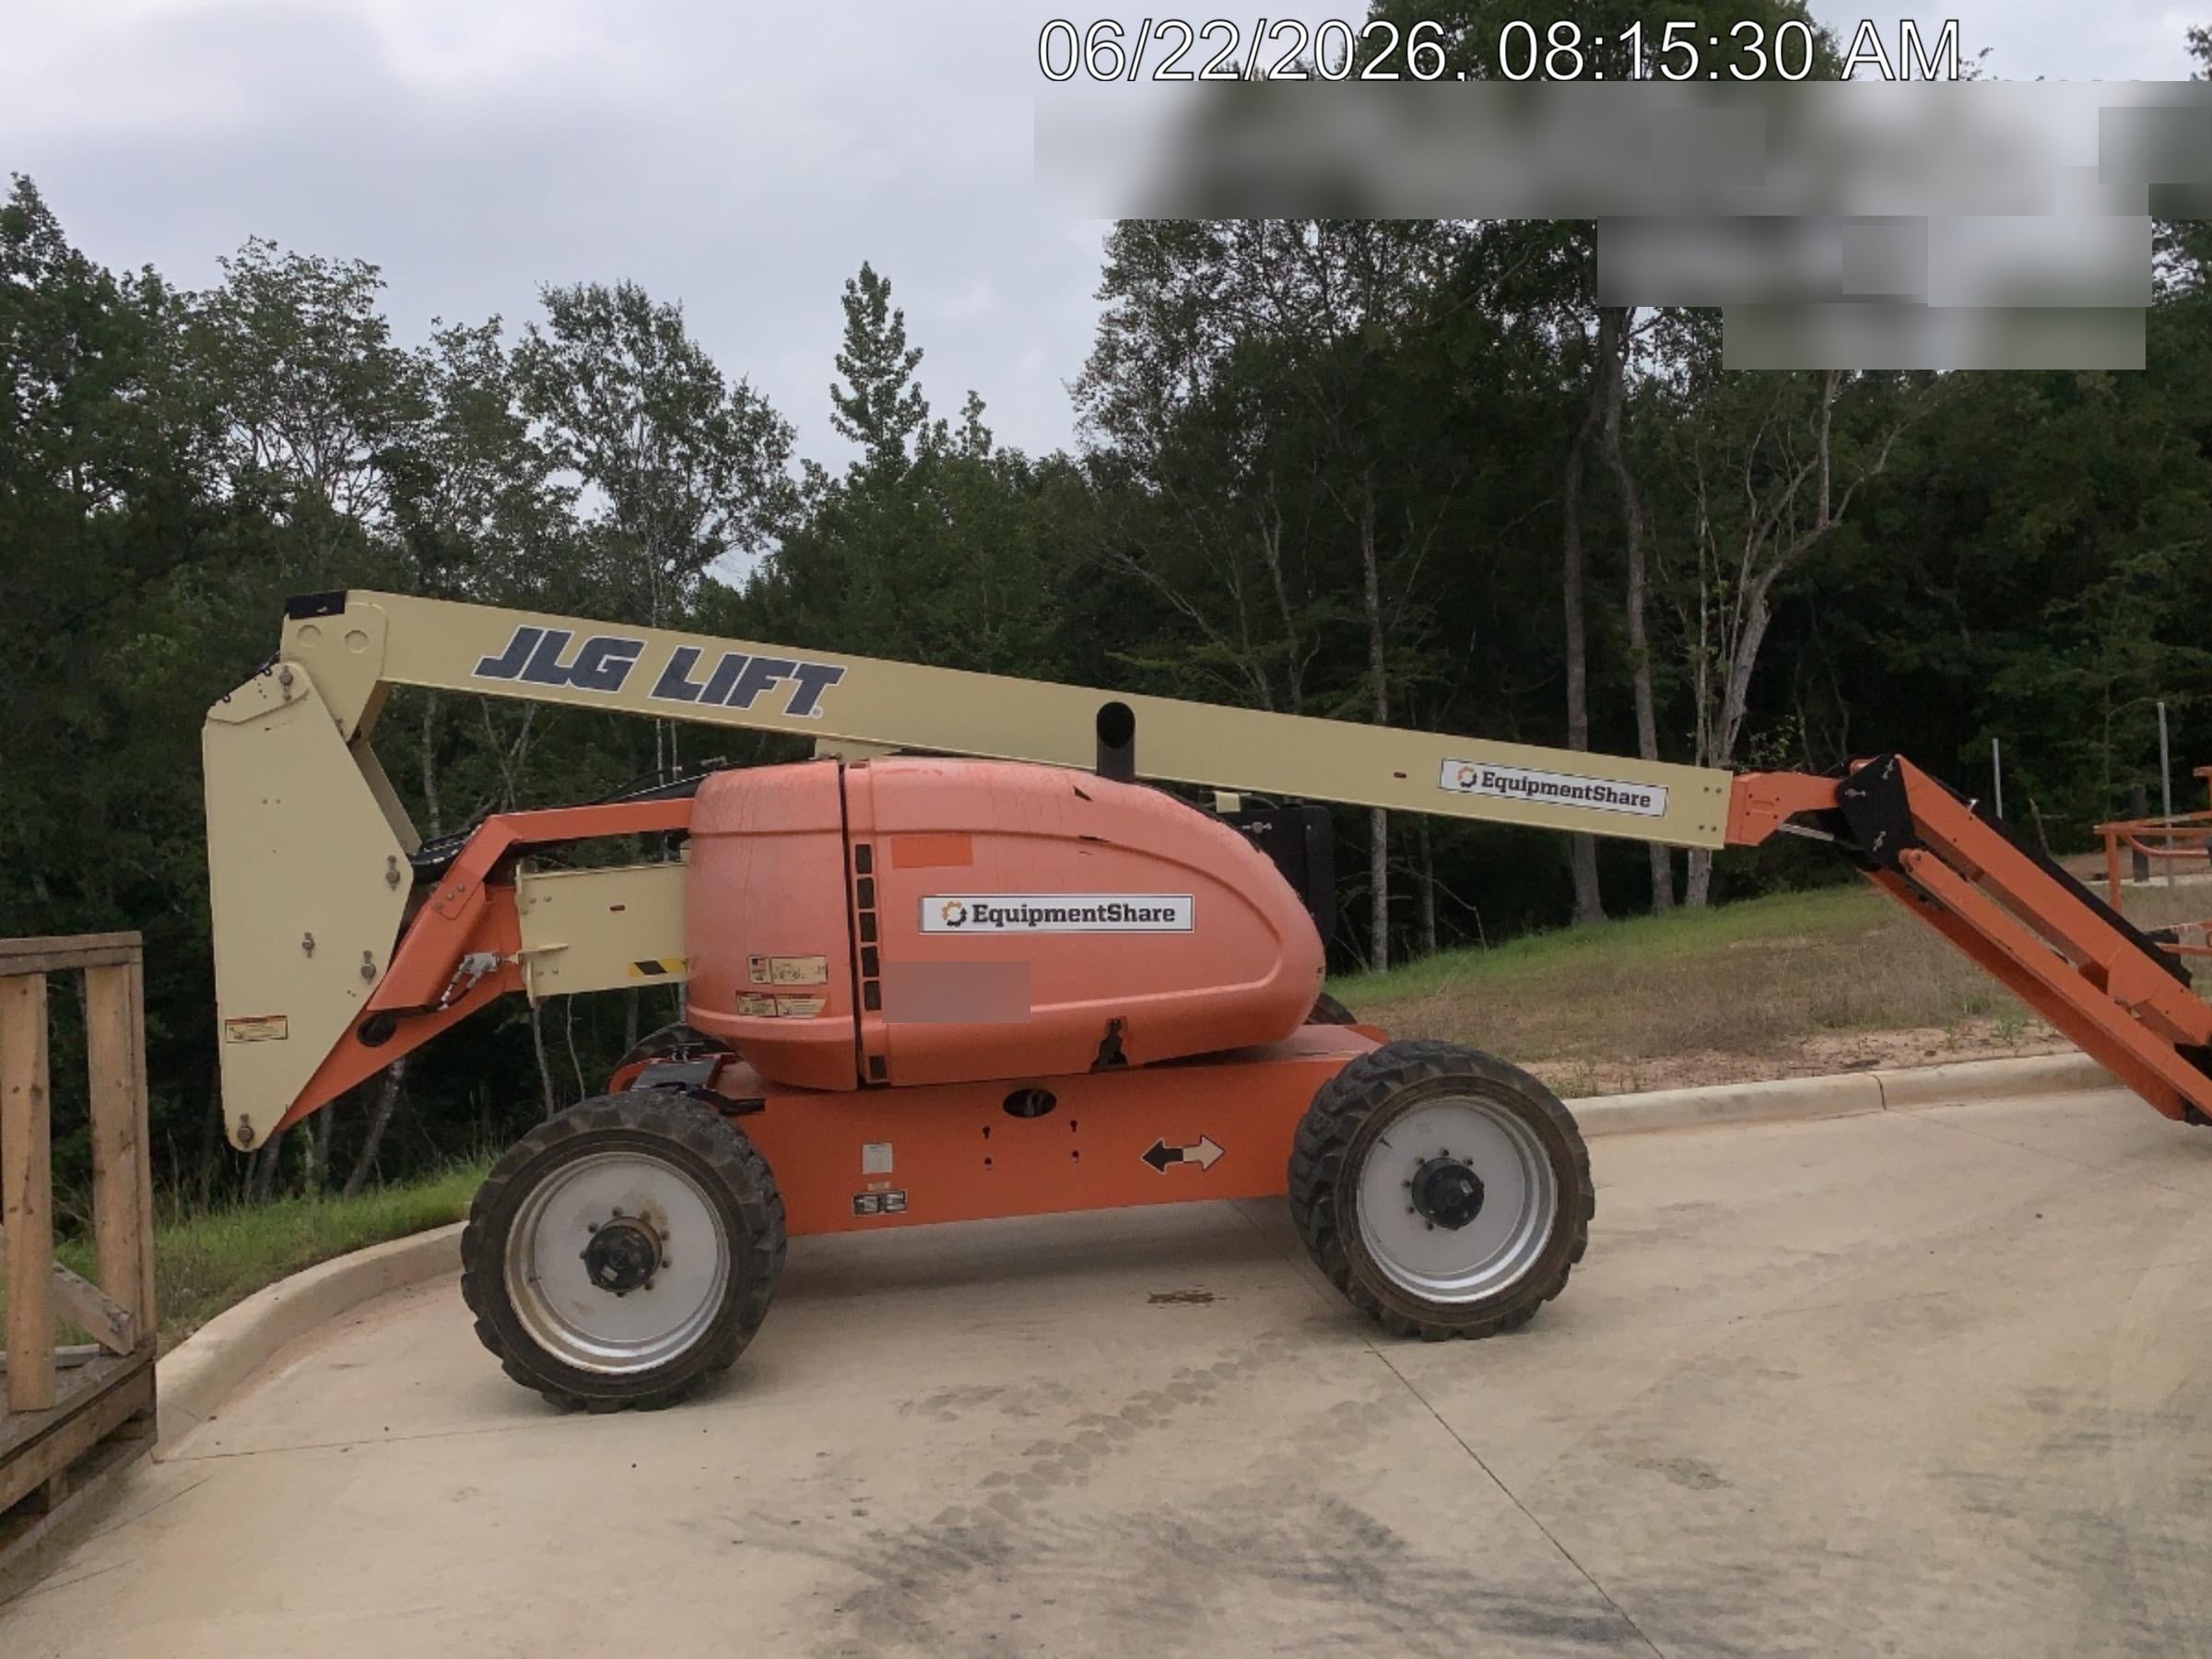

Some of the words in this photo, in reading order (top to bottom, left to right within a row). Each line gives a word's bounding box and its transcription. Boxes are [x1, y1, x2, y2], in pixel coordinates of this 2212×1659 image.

[472, 626, 648, 693] JLG
[648, 646, 846, 717] LIFT
[1481, 771, 1651, 807] EquipmentShare
[971, 903, 1175, 927] EquipmentShare
